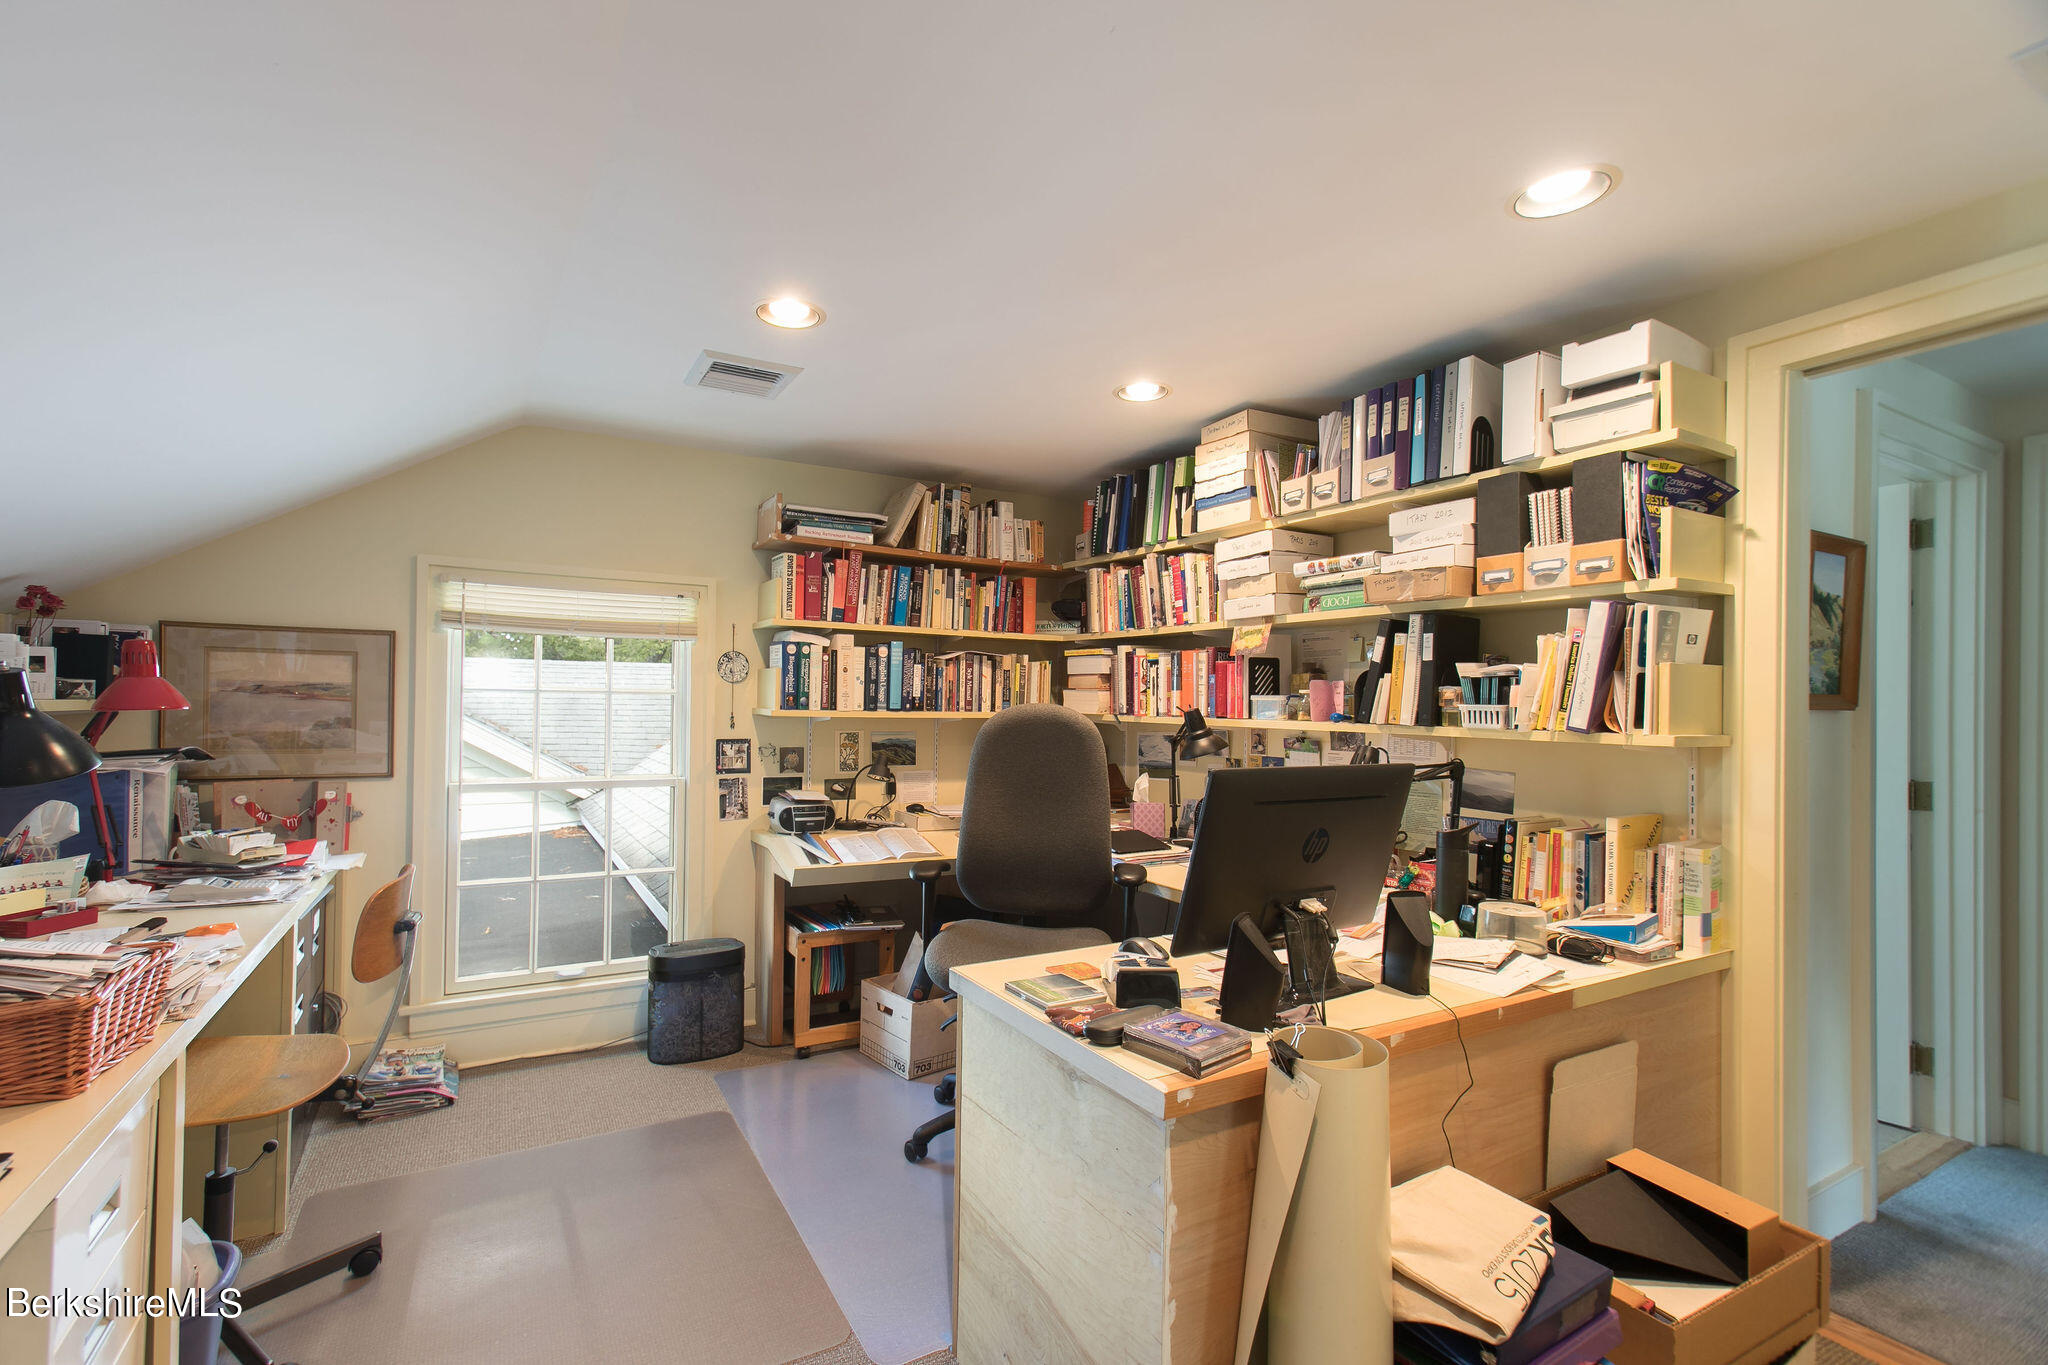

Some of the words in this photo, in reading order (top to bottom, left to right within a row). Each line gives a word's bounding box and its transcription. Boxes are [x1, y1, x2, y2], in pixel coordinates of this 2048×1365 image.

[1664, 484, 1688, 496] Reports
[1665, 476, 1704, 490] Consumer
[1645, 493, 1663, 505] BEST
[1322, 596, 1350, 608] FOOD
[787, 655, 796, 693] Biographical
[879, 658, 887, 682] English
[878, 682, 887, 703] Usage
[132, 779, 141, 839] Renaissance
[256, 811, 269, 822] ALL
[286, 817, 298, 827] MY
[1303, 830, 1329, 862] hp
[893, 1060, 906, 1073] 703
[915, 1062, 932, 1074] 703
